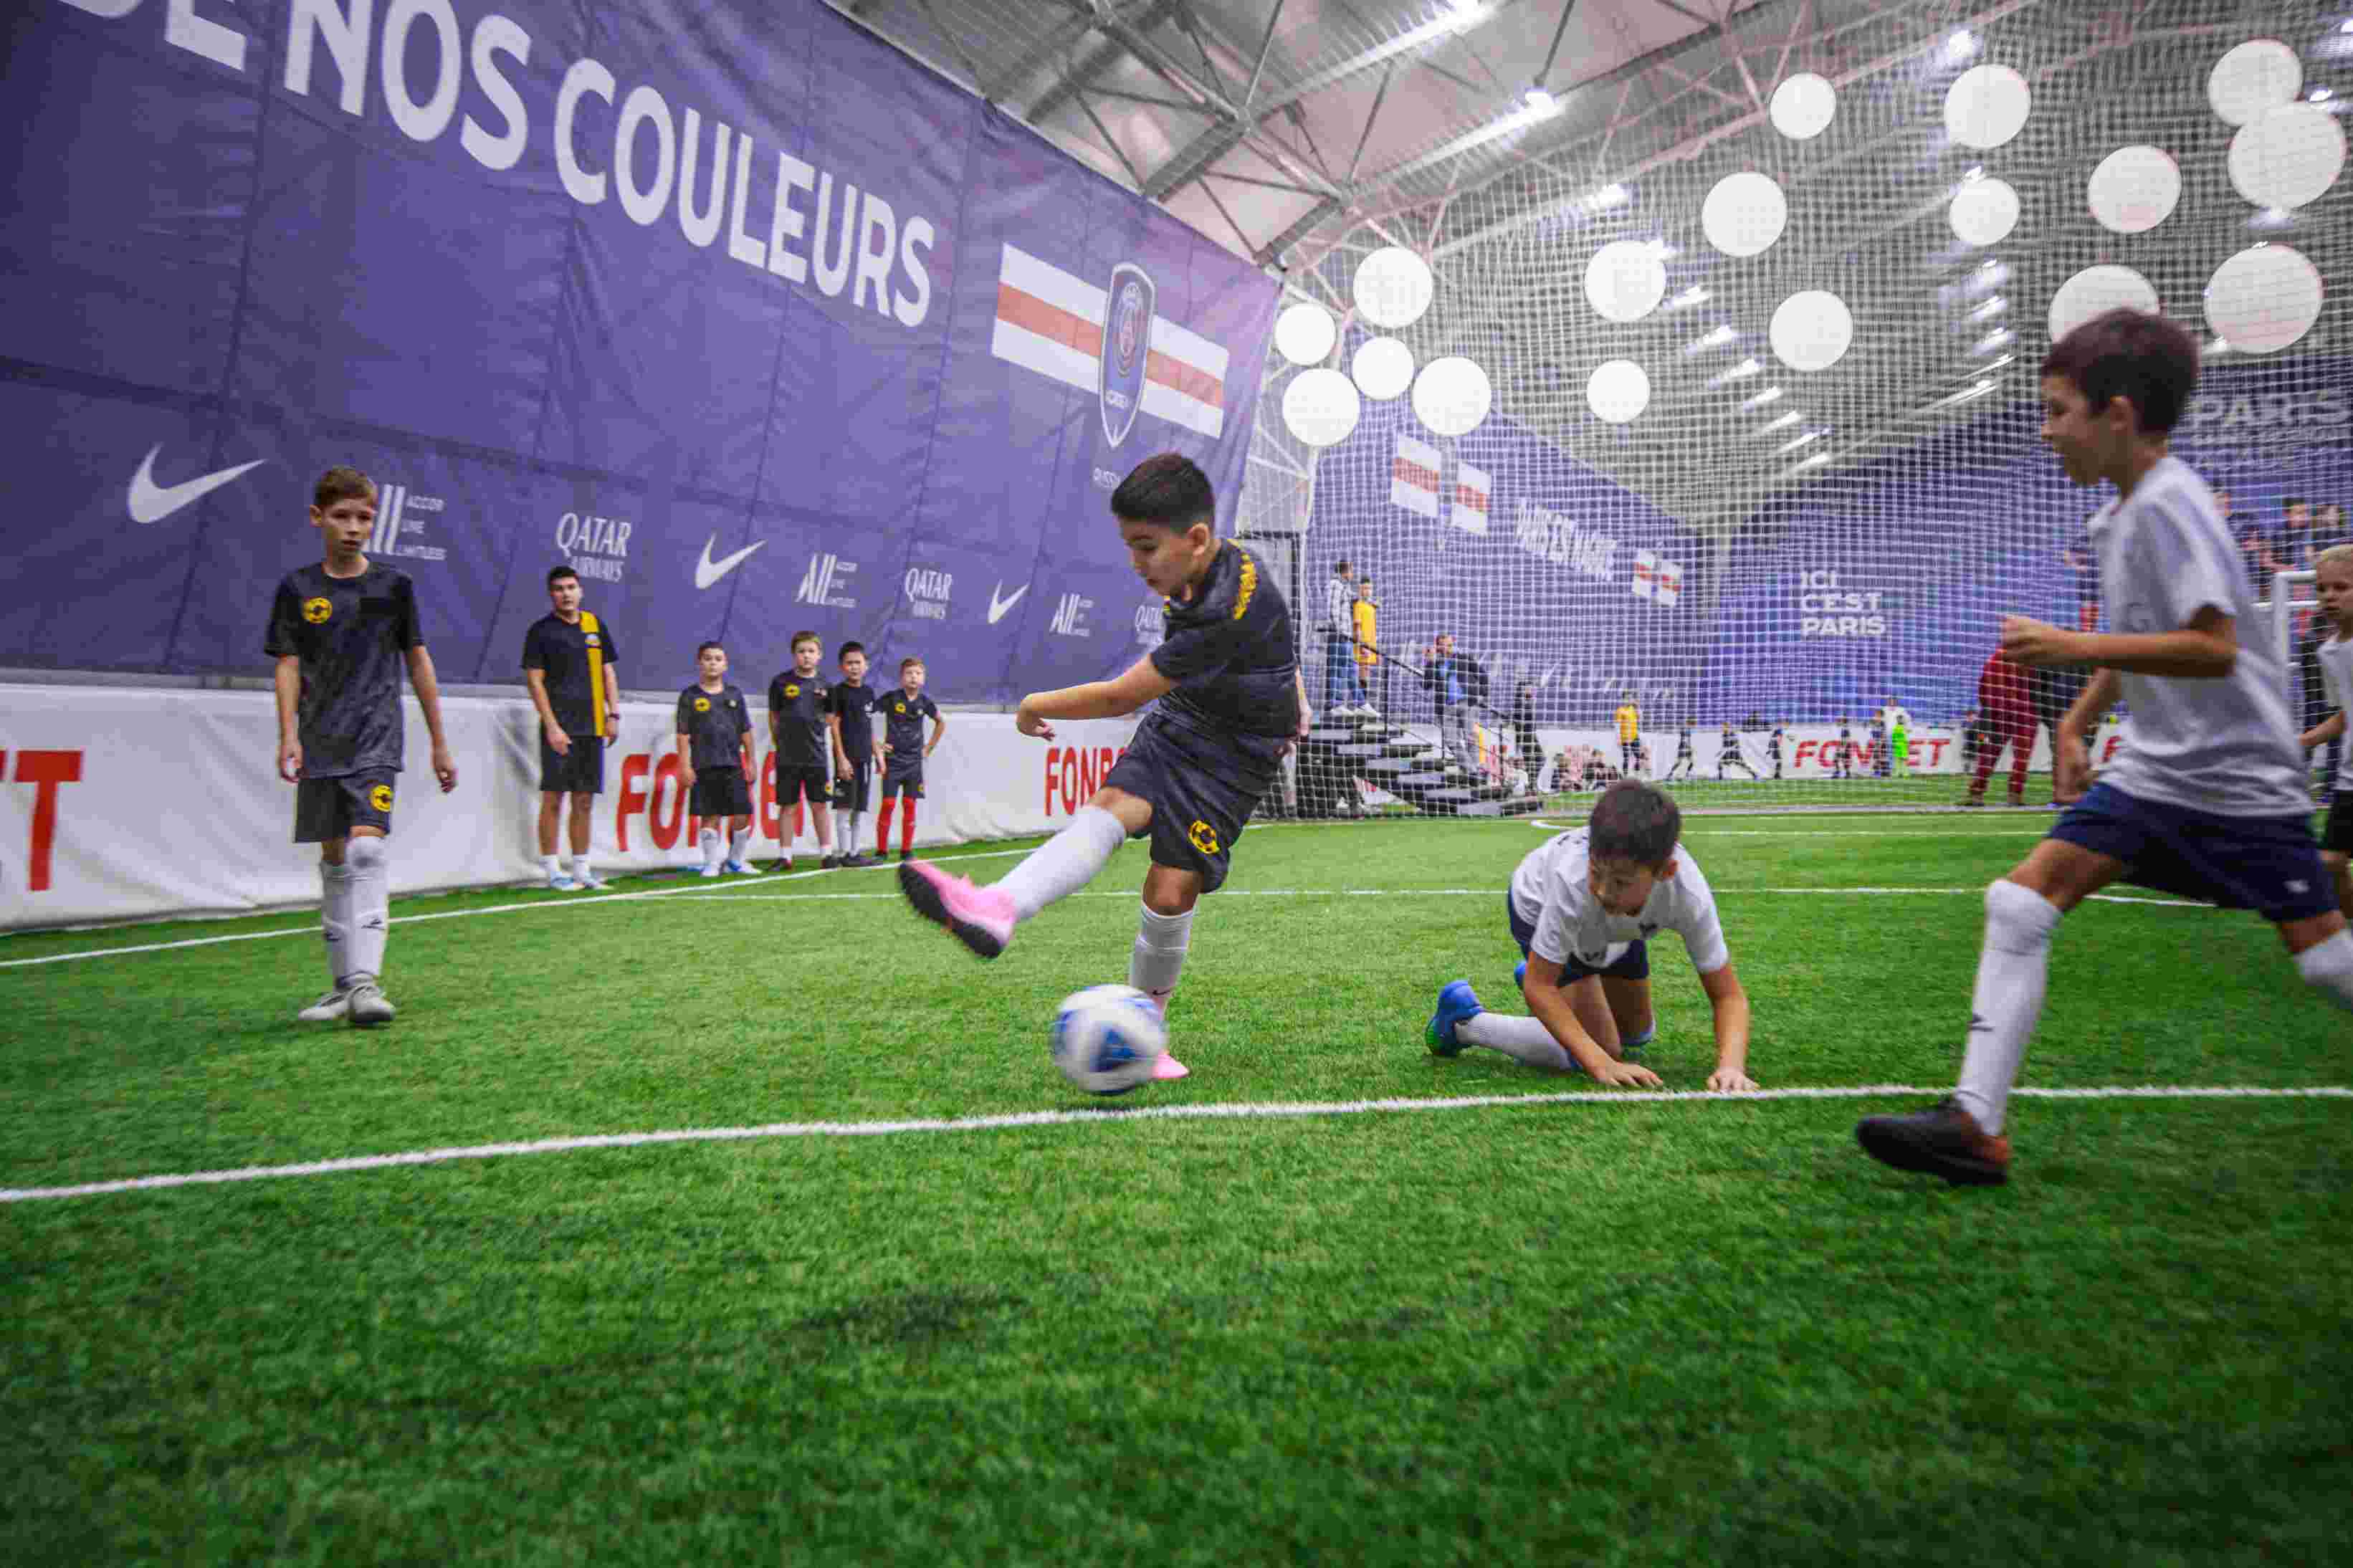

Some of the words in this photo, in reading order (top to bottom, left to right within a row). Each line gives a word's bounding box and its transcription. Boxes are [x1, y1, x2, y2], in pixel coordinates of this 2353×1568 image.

[285, 0, 532, 171] NOS
[554, 58, 934, 327] COULEURS
[555, 512, 632, 557] QATAR
[905, 568, 952, 603] QATAR
[1801, 571, 1837, 588] ICI
[1800, 616, 1886, 636] PARIS
[1794, 738, 1950, 769] FONET
